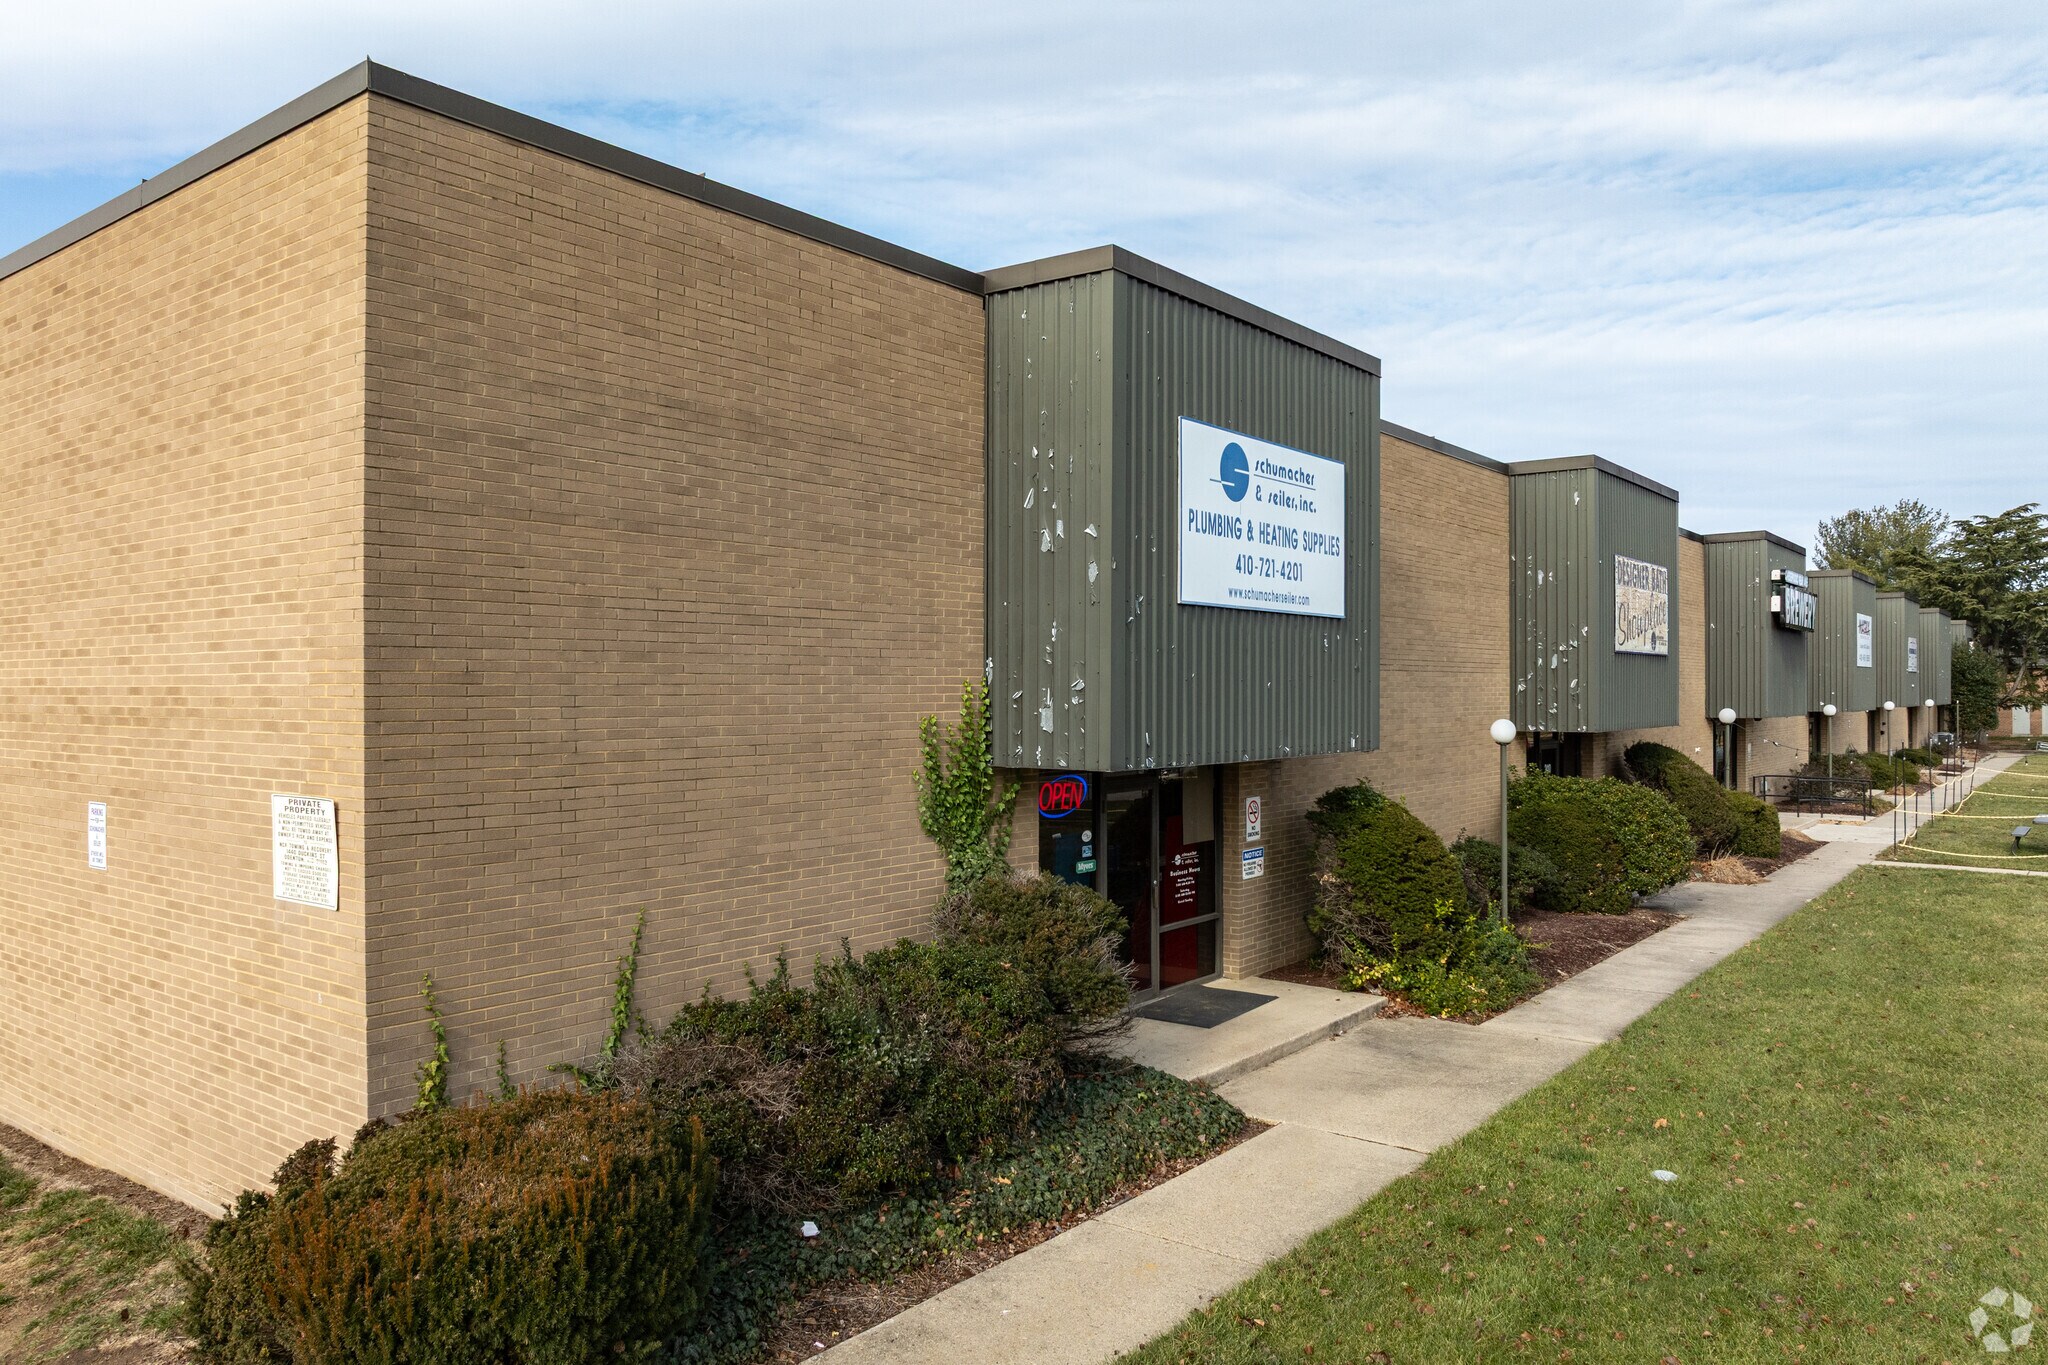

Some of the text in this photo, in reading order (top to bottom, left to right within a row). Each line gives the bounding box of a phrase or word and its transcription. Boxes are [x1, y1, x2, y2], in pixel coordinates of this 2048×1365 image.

[1255, 458, 1315, 486] schumacher
[1256, 485, 1316, 513] & seiler, inc.
[1188, 509, 1340, 557] PLUMBING & HEATING SUPPLIES
[1236, 554, 1303, 582] 410-721-4201
[1617, 558, 1667, 594] DESIGNER BATH
[1228, 587, 1310, 606] www.schumacherseiler.com
[1618, 596, 1666, 647] Showplace
[289, 799, 321, 808] PRIVATE
[1038, 782, 1082, 810] OPEN
[285, 806, 325, 815] PROPERTY
[1244, 850, 1262, 858] NOTICE
